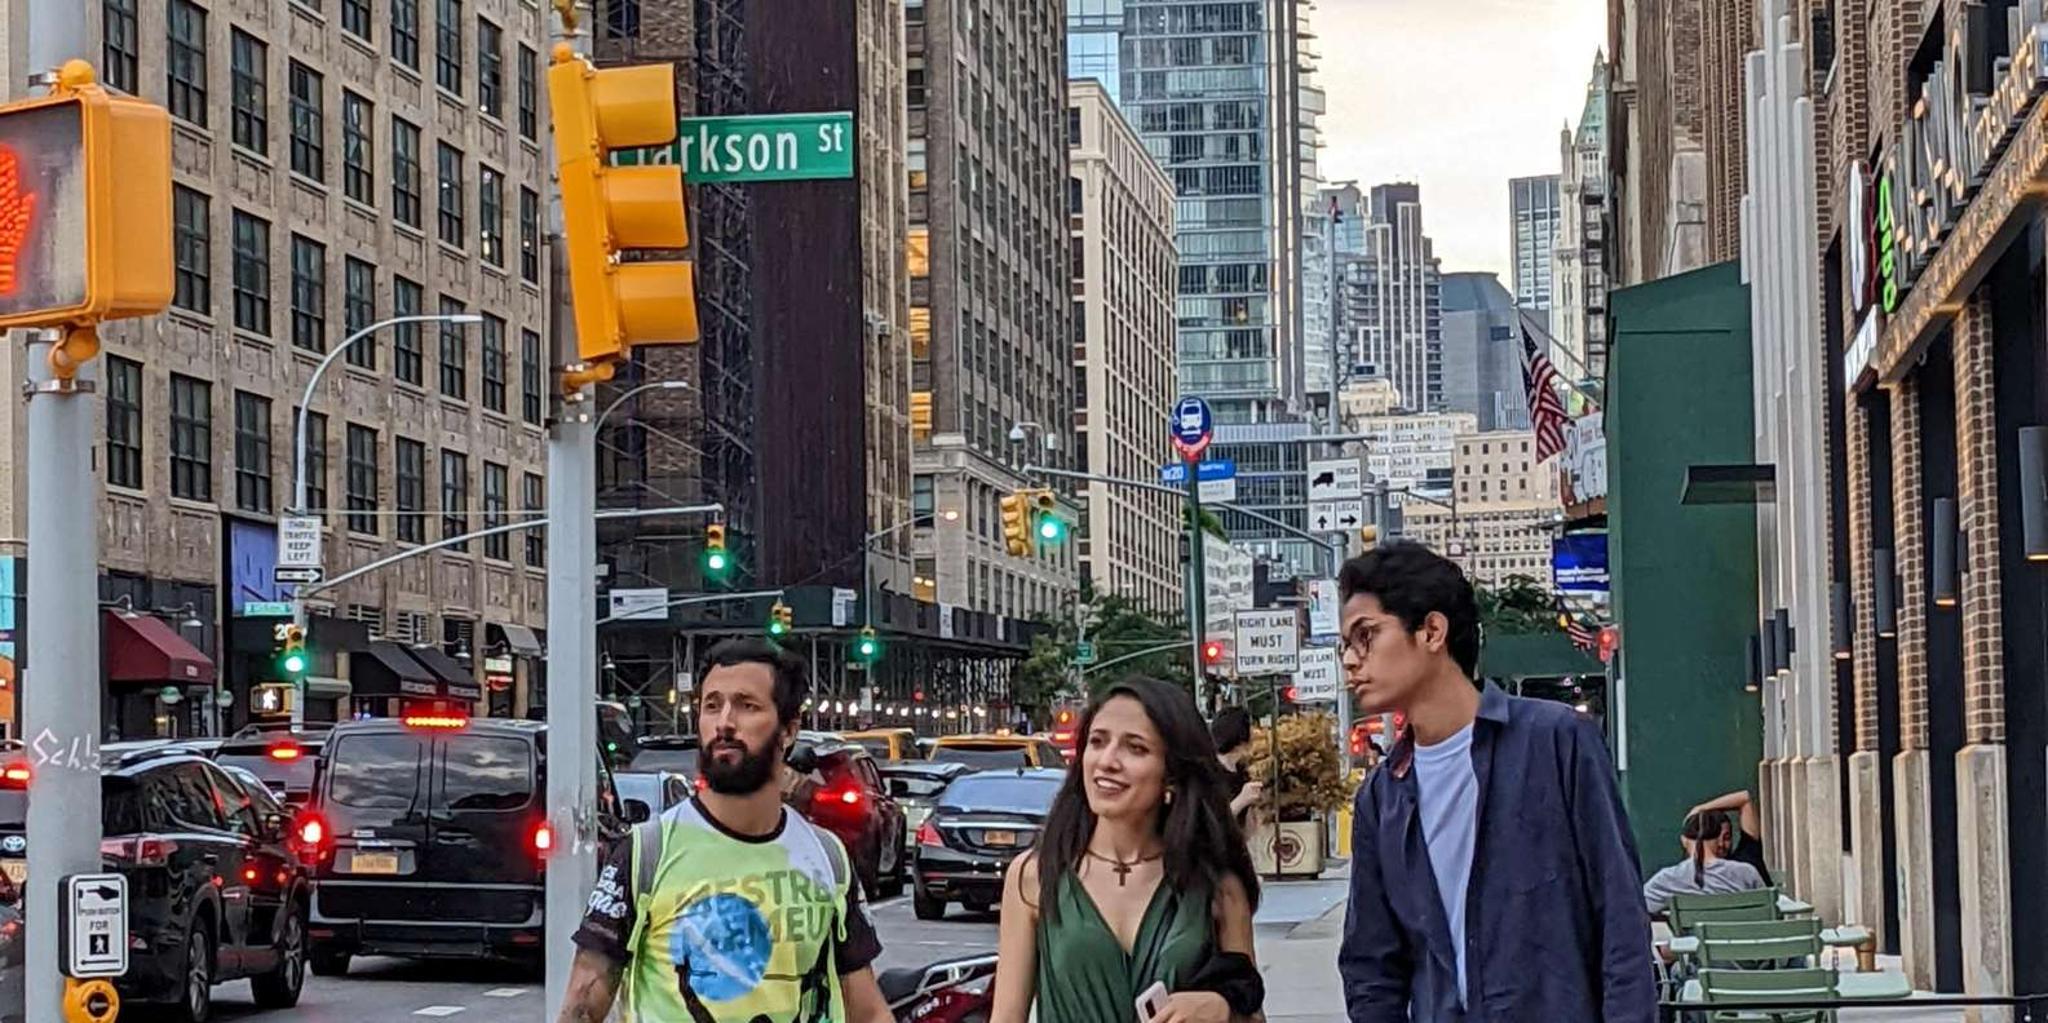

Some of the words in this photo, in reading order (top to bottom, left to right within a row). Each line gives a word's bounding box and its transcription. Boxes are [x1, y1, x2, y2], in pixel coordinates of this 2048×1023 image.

[819, 122, 844, 152] St
[287, 542, 311, 550] KEEP
[287, 552, 311, 561] LEFT
[1238, 618, 1266, 629] RIGHT
[1269, 616, 1293, 628] LANE
[1250, 634, 1282, 648] MUST
[1239, 655, 1264, 667] TURN
[1267, 653, 1296, 665] RIGHT
[1303, 668, 1326, 679] MUST
[89, 920, 109, 931] FOR
